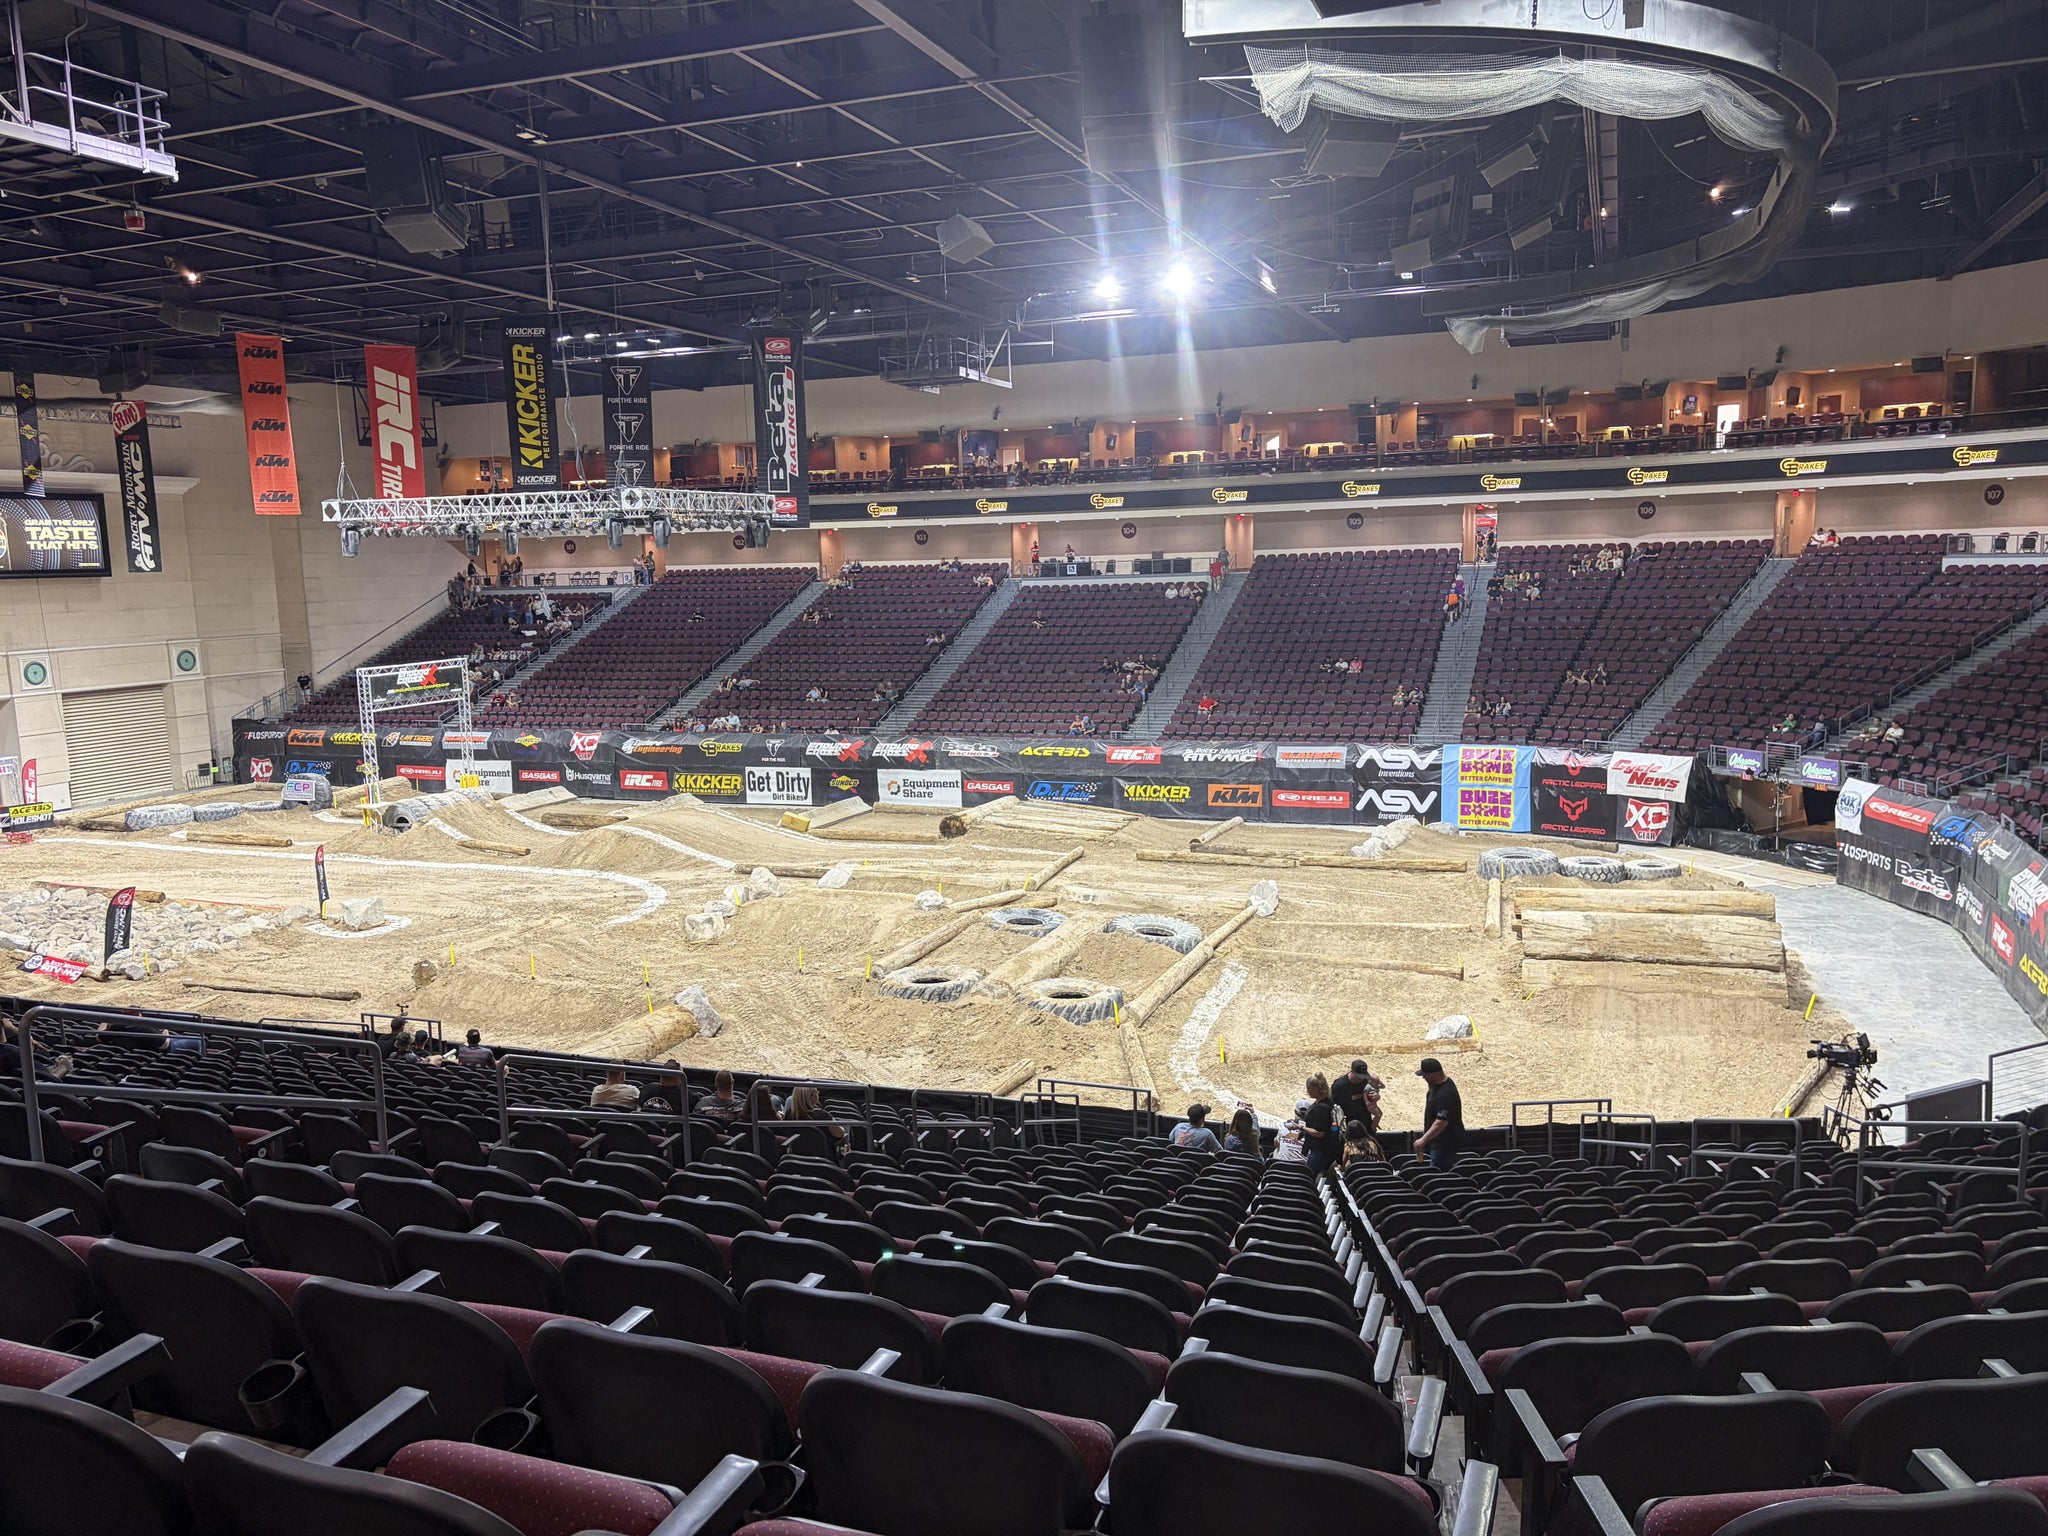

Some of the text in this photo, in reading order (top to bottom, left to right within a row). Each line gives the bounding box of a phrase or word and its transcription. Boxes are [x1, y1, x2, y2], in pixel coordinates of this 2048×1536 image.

[243, 345, 278, 360] KTM
[248, 381, 282, 395] KTM
[512, 343, 543, 450] KICKER
[536, 353, 550, 459] PERFORMANCE AUDIO
[251, 418, 286, 431] KTM
[765, 372, 790, 493] Beta
[787, 403, 799, 475] RACING
[255, 454, 289, 467] KTM
[122, 442, 140, 551] ROCKY MOUNTAIN
[259, 490, 294, 503] KTM
[1986, 490, 2001, 500] 107
[1640, 505, 1654, 515] 106
[1349, 517, 1361, 526] 105
[25, 526, 97, 540] TASTE
[27, 540, 98, 550] THAT HITS
[248, 731, 286, 740] FLOSPORTS
[290, 732, 321, 743] KTM
[570, 735, 600, 752] XC
[634, 745, 683, 754] Engineering
[1356, 749, 1439, 770] ASV
[1611, 759, 1662, 773] Cycle
[522, 772, 557, 780] GASGAS
[574, 773, 612, 781] Husqvarna
[1378, 769, 1415, 778] inventions
[287, 782, 311, 792] FCP
[686, 775, 743, 789] KICKER
[747, 770, 810, 800] Get Dirty
[903, 778, 960, 789] Equipment
[967, 782, 1011, 791] GASGAS
[1542, 778, 1606, 790] ARCTIC LEOPARD
[1628, 772, 1680, 789] News
[903, 789, 933, 798] Share
[1033, 783, 1059, 796] Dirt
[1134, 784, 1191, 799] KICKER
[1211, 787, 1259, 804] KTM
[786, 793, 804, 801] Bikes
[1355, 788, 1438, 814] ASV
[1460, 789, 1512, 805] BUZZ
[1840, 794, 1857, 809] FOX
[11, 813, 53, 826] HOLESHOT
[1378, 811, 1414, 820] inventions
[1624, 803, 1668, 829] XC
[1888, 807, 1928, 823] RIEJU
[1483, 819, 1510, 827] CAFFEINE
[1540, 823, 1606, 836] ARCTIC LEOPARD
[1637, 831, 1655, 840] GEAR
[1895, 859, 1949, 893] Beta
